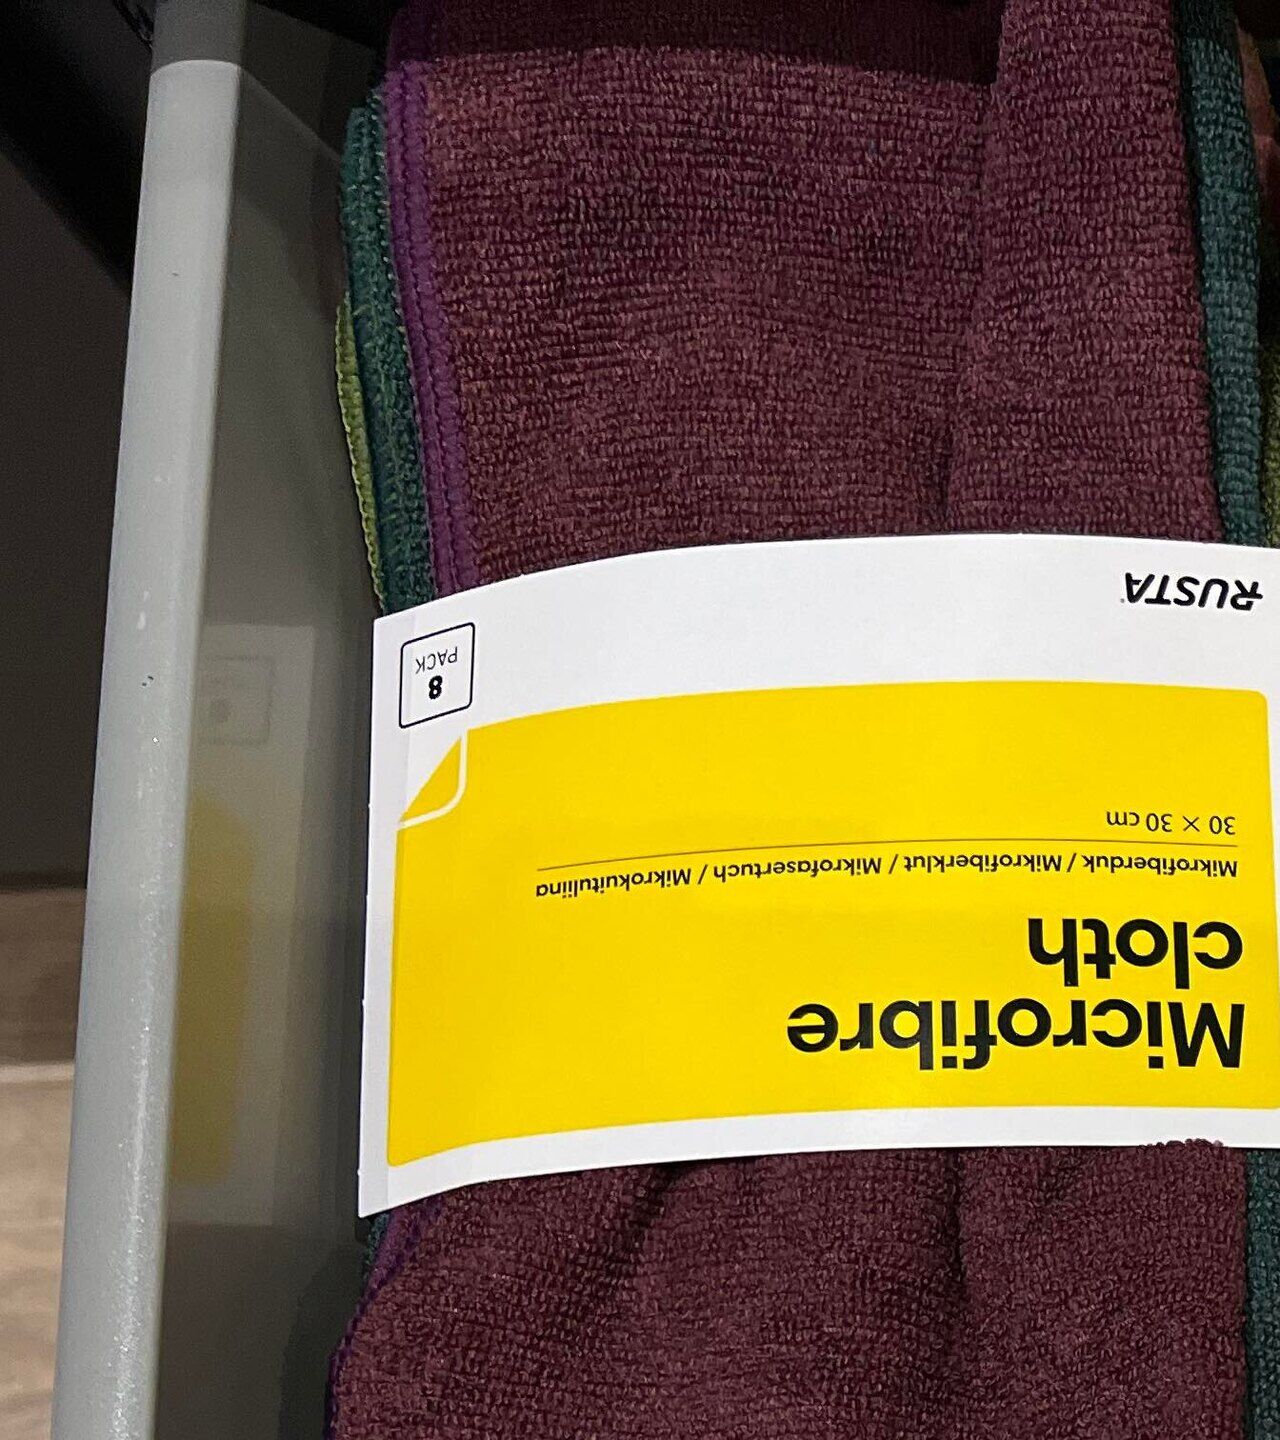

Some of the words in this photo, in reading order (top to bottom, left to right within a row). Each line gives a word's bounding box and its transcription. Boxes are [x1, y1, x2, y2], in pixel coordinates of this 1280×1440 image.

[1121, 574, 1263, 610] RUSTA
[416, 647, 457, 673] PACK
[1107, 812, 1140, 826] cm
[1146, 813, 1172, 832] 30
[1209, 816, 1235, 835] 30
[714, 858, 881, 881] Mikrofasertuch
[904, 855, 1062, 872] Mikrofiberklut
[1082, 856, 1237, 877] Mikrofiberduk
[536, 869, 691, 897] Mikrokuituliina
[1028, 919, 1242, 987] cloth
[787, 1000, 1244, 1068] Microfibre
